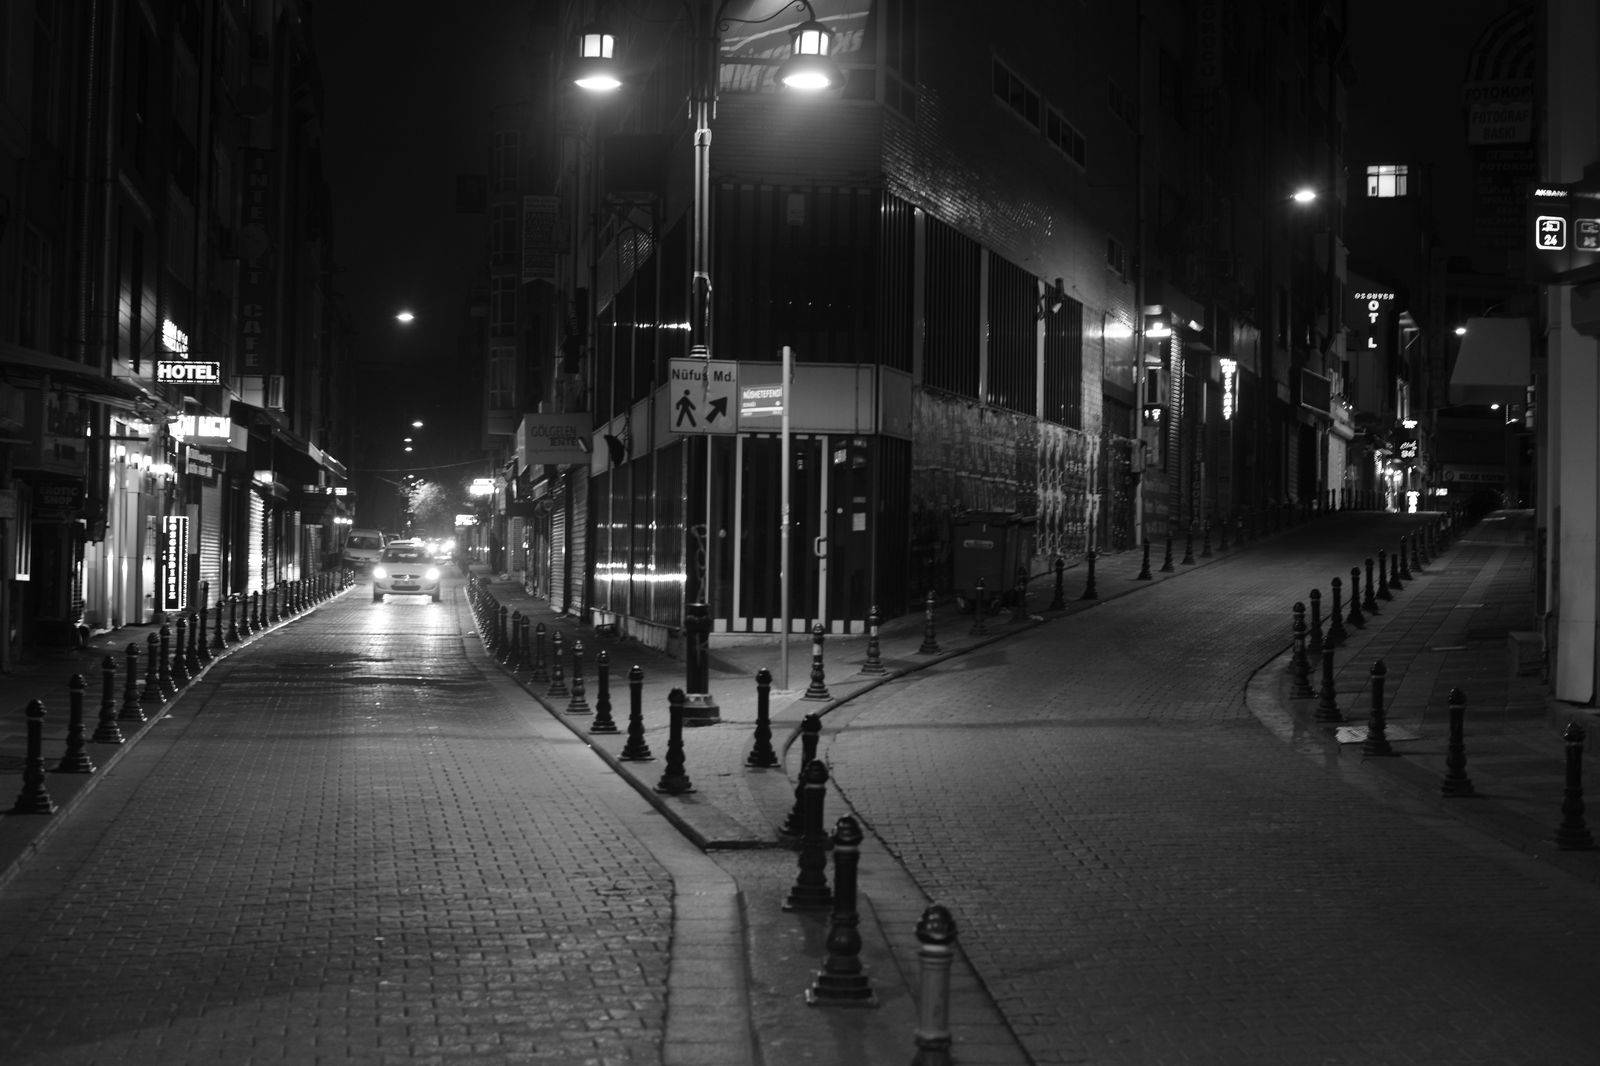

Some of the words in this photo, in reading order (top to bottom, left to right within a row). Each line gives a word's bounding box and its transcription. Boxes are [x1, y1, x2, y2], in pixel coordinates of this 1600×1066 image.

[1535, 189, 1567, 197] AKBANK
[1544, 234, 1557, 245] 24
[158, 364, 217, 380] HOTEL
[671, 368, 708, 382] Nüfus
[713, 370, 736, 382] Md.
